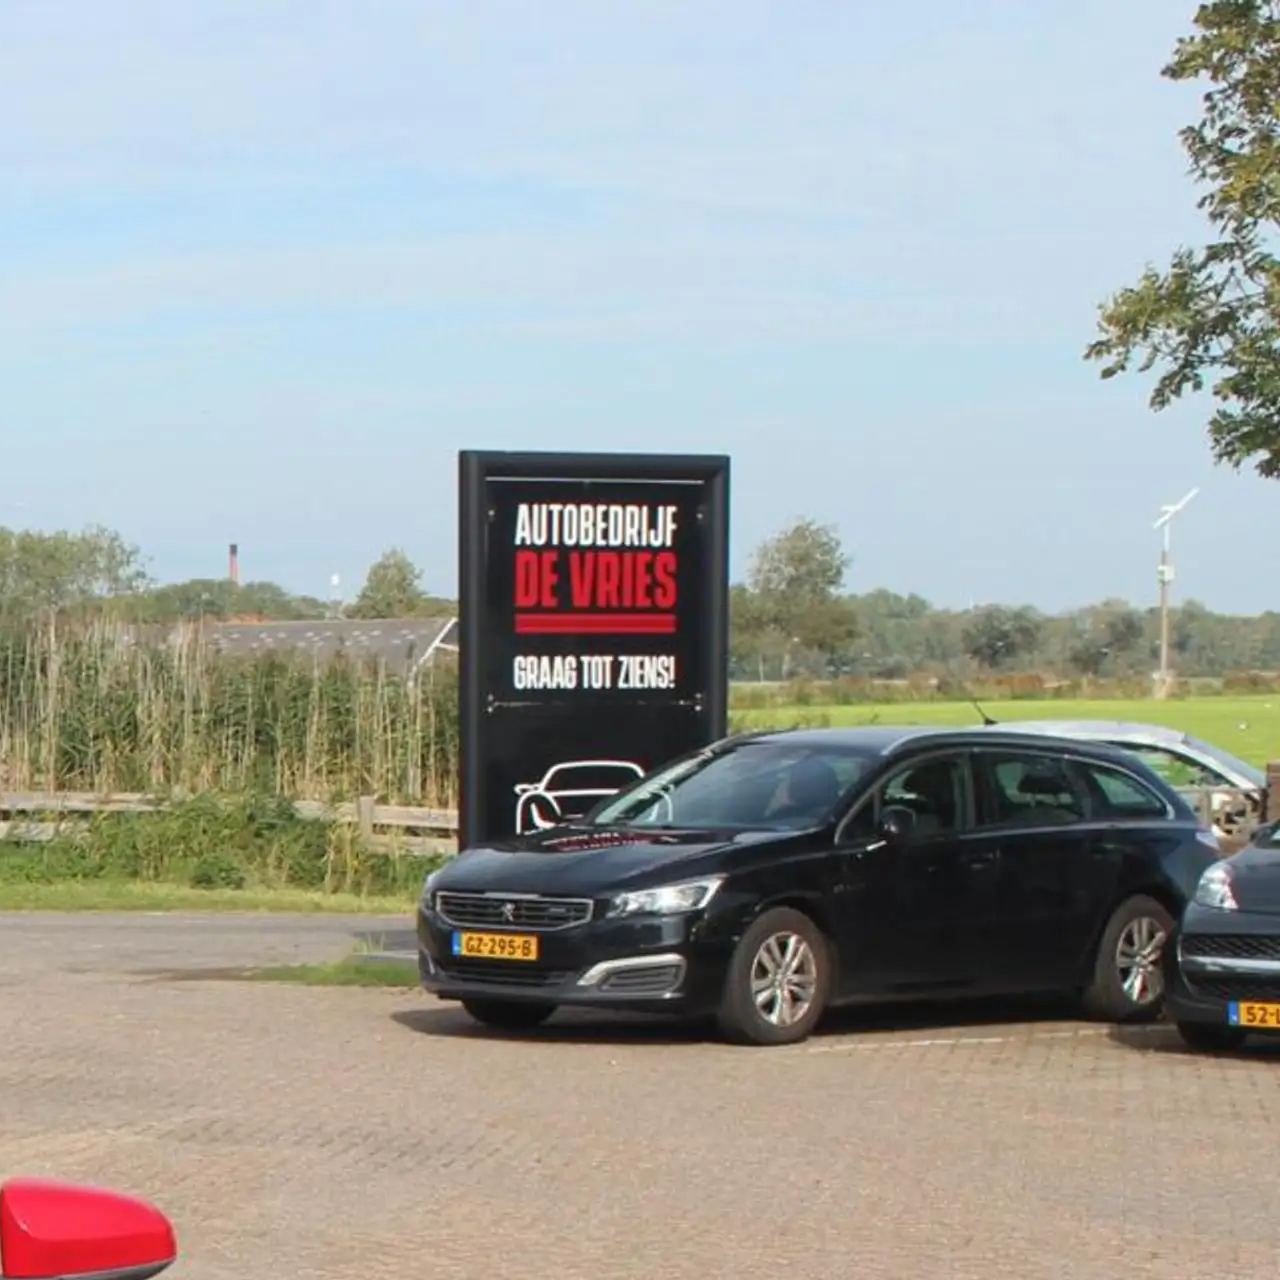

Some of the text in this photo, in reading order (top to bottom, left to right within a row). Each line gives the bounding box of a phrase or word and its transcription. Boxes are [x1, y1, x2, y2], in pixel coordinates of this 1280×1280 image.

[514, 503, 678, 547] AUTOBEDRIJF
[514, 551, 678, 608] DE VRIES
[513, 655, 676, 690] GRAAG TOT ZIENS!
[466, 935, 532, 957] GZ-295-B
